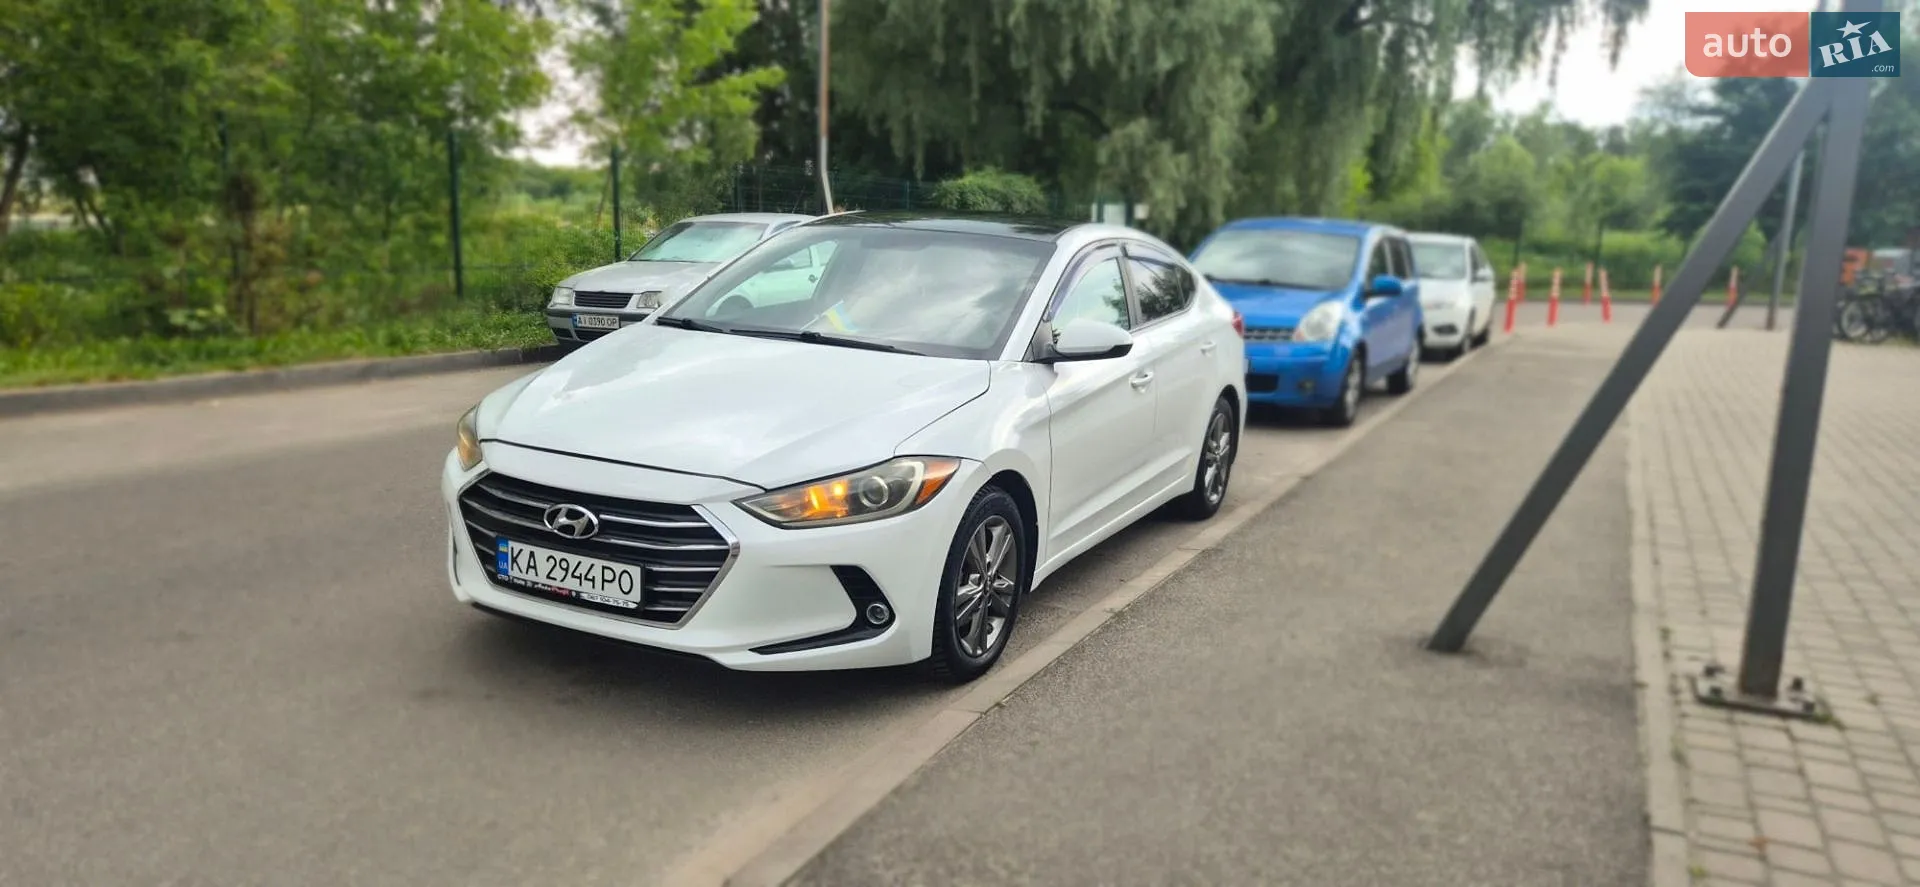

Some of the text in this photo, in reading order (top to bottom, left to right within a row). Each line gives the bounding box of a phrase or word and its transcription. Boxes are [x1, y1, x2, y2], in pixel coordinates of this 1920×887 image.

[498, 560, 508, 569] UA
[510, 546, 538, 577] KA
[545, 555, 596, 590] 2944
[601, 565, 634, 595] PO
